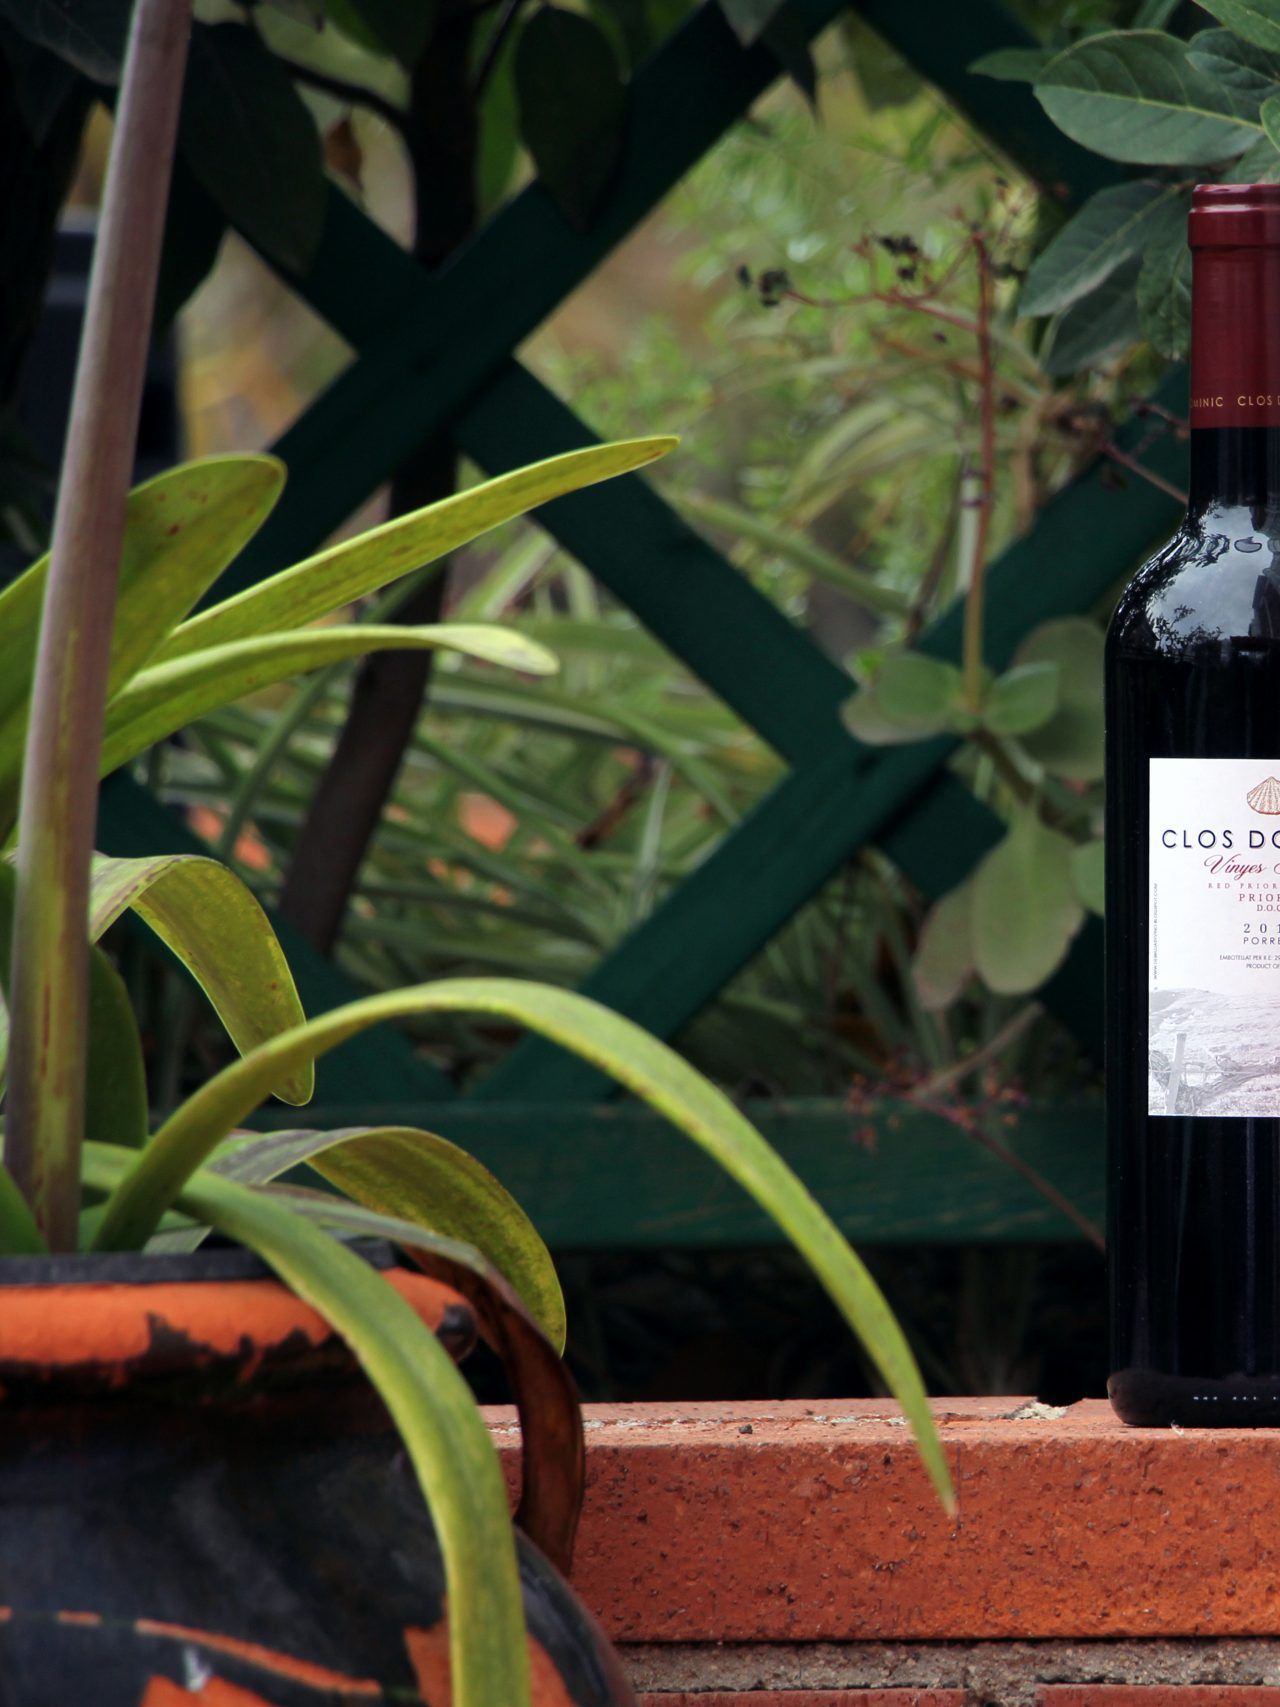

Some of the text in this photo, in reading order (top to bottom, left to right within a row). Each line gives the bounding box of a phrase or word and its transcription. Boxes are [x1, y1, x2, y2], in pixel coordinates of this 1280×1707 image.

[1237, 395, 1273, 407] CLOS
[1161, 829, 1234, 849] CLOS
[1204, 853, 1267, 881] Vinyes
